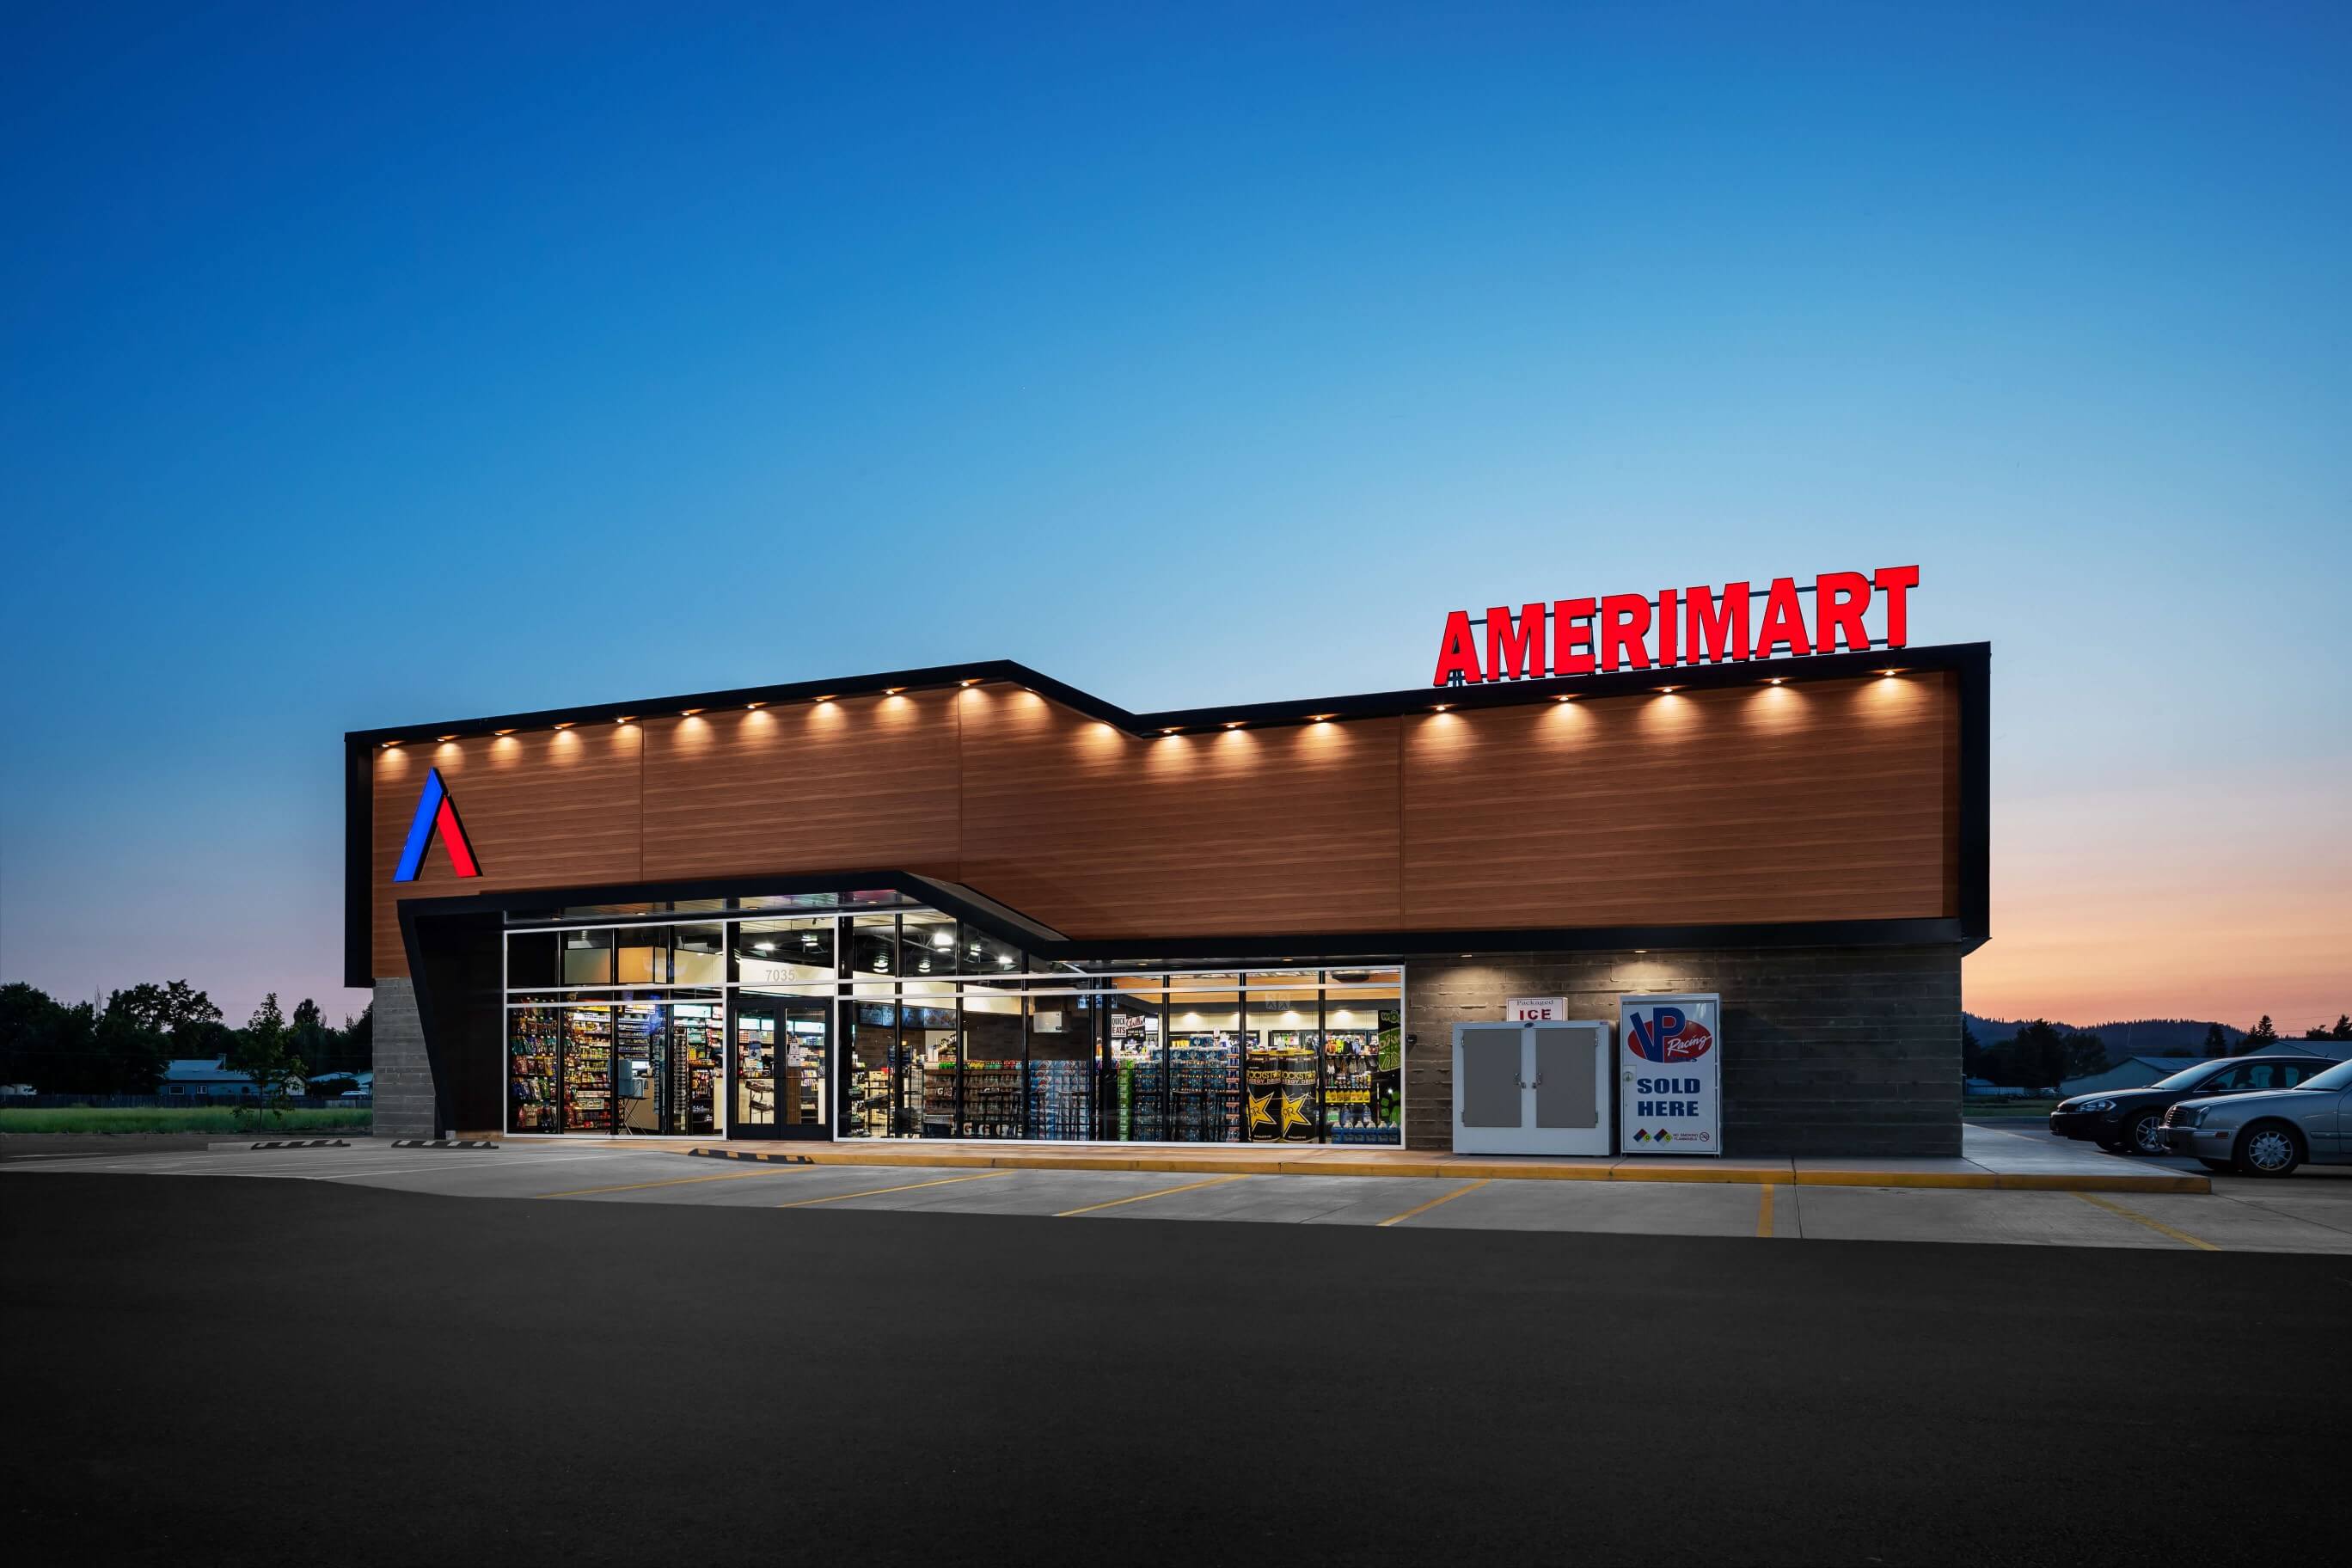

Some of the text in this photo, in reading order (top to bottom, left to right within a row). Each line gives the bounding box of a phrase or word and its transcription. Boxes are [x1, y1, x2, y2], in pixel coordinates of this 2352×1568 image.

[1434, 565, 1919, 688] AMERIMART
[765, 969, 795, 983] 7035
[1112, 1017, 1125, 1026] QUICK
[1520, 1008, 1552, 1020] ICE
[1630, 1008, 1686, 1063] VP
[1667, 1034, 1712, 1057] Racing
[1637, 1078, 1700, 1094] SOLD
[1638, 1100, 1700, 1117] HERE
